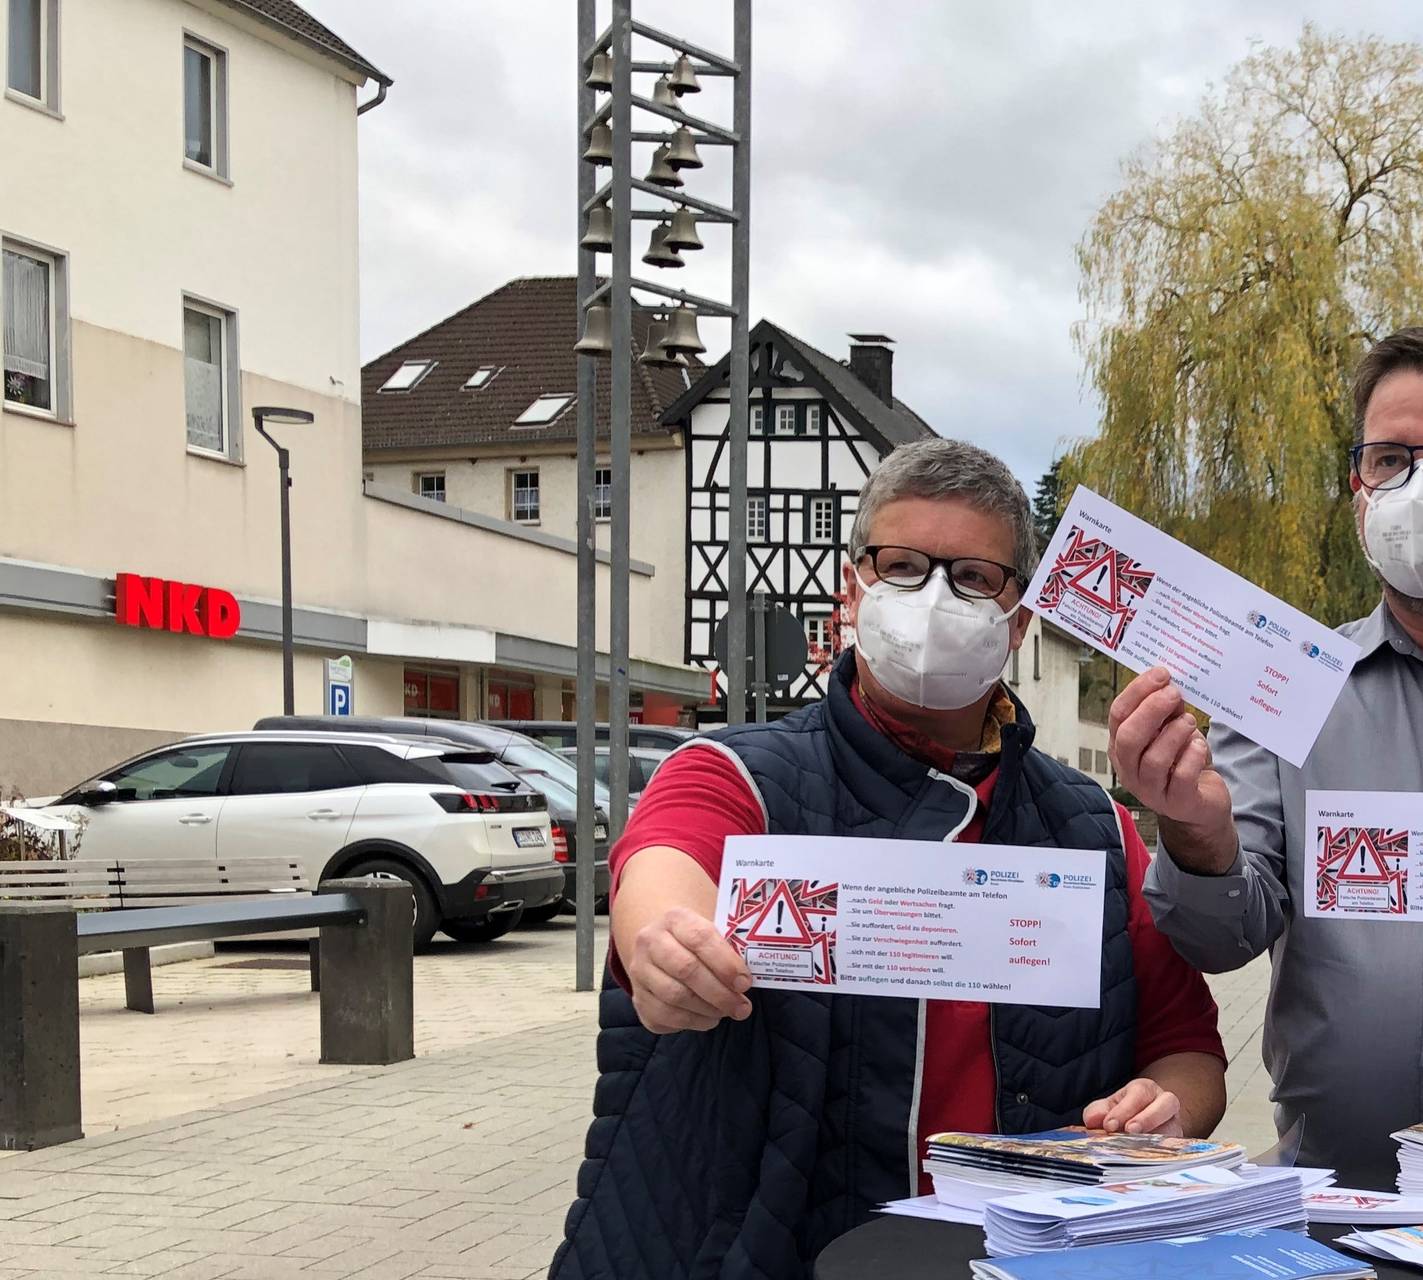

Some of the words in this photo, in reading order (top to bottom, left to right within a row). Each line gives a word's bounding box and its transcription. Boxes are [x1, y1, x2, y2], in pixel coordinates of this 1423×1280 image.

[1079, 508, 1112, 534] Warnkarte
[116, 573, 240, 639] NKD
[1071, 598, 1101, 619] ACHTUNG!
[1268, 621, 1290, 636] POLIZEI
[1134, 651, 1155, 667] auflege
[1321, 651, 1342, 666] POLIZEI
[1264, 665, 1289, 683] STOPP!
[1257, 679, 1278, 696] Sofort
[336, 688, 346, 716] P
[1249, 694, 1281, 717] auflegen!
[1318, 809, 1354, 818] Warnkarte
[735, 859, 774, 868] Warnkarte
[990, 870, 1019, 878] POLIZEI
[879, 885, 915, 894] angebliche
[917, 887, 967, 896] Polizeibeamte
[1009, 918, 1041, 928] STOPP!
[1009, 936, 1036, 946] Sofort
[758, 951, 799, 960] ACHTUNG!
[1008, 955, 1050, 967] auflegen!
[858, 975, 888, 984] auflegen
[905, 977, 931, 985] danach
[933, 979, 953, 987] selbst
[982, 982, 1011, 990] wählen!
